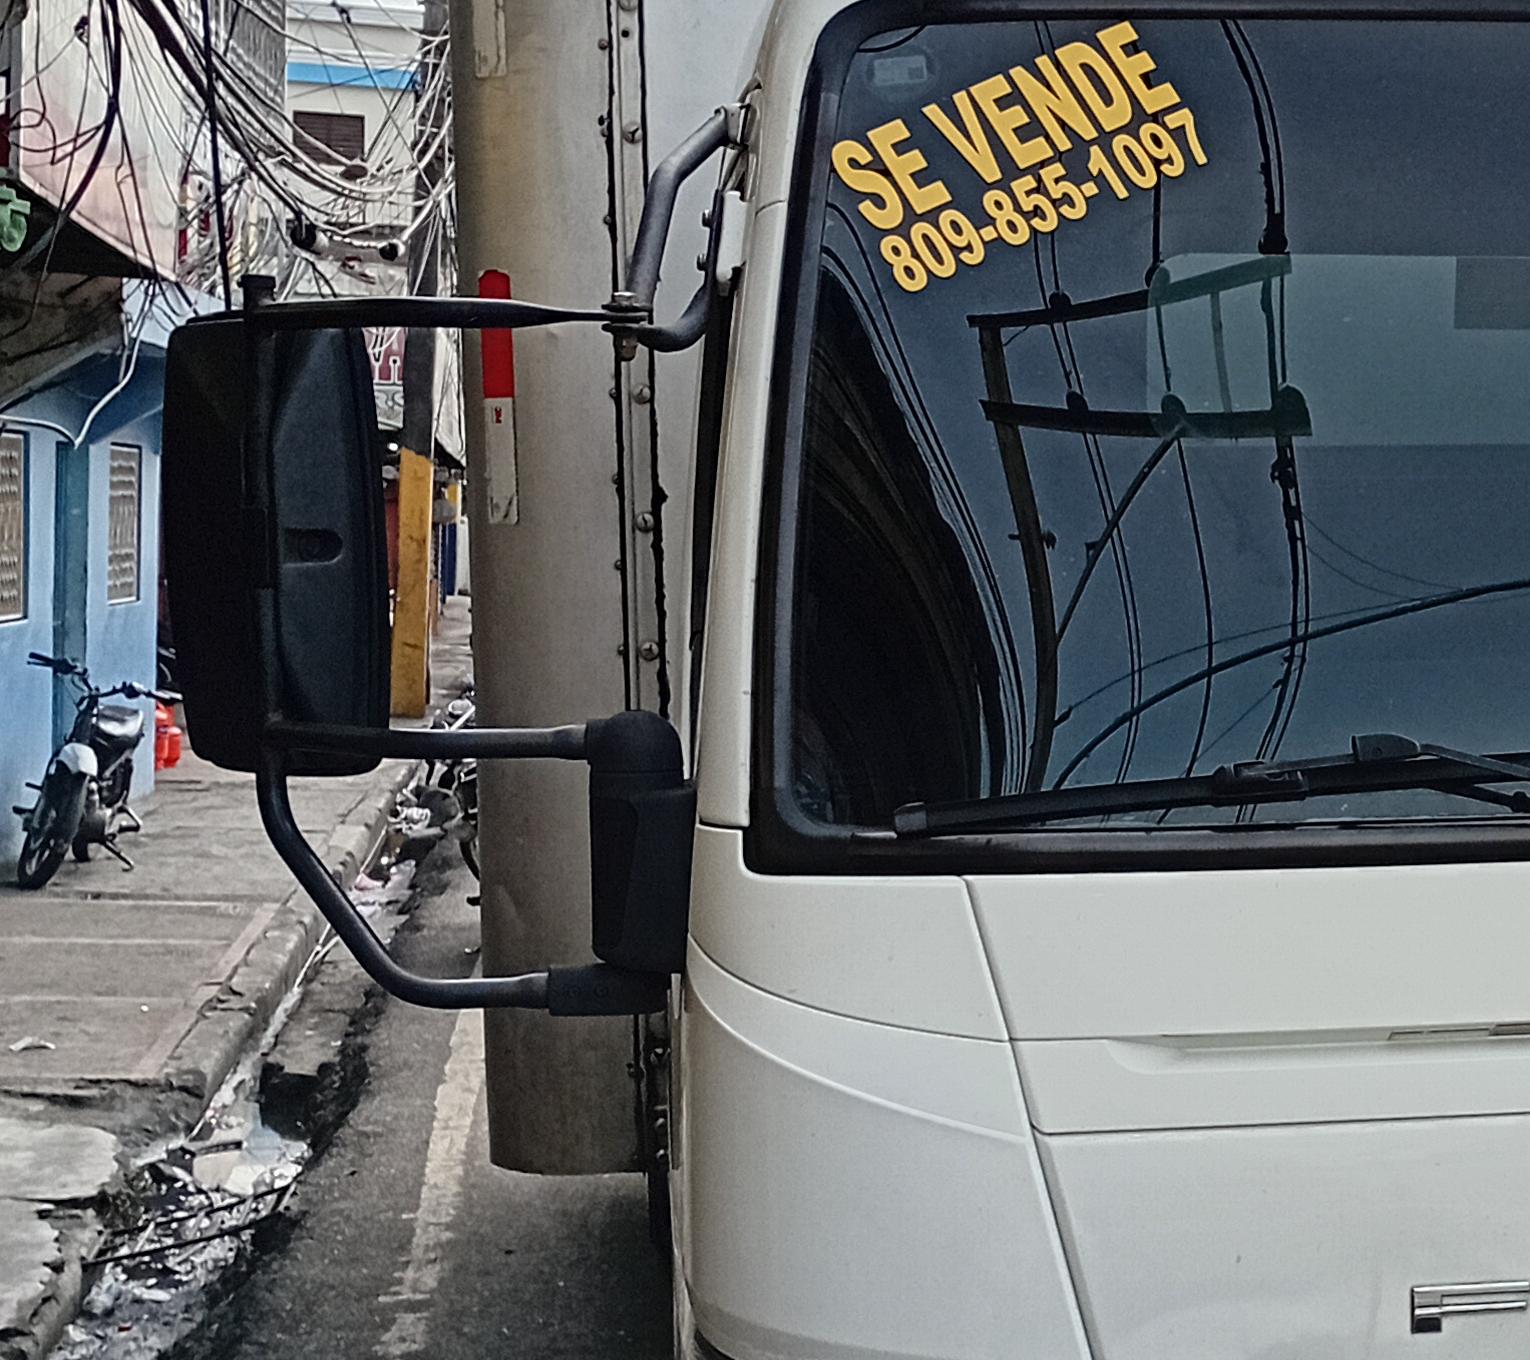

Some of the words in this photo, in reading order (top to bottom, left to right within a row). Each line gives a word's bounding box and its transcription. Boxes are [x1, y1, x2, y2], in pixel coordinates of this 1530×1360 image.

[831, 118, 952, 230] SE
[921, 20, 1182, 184] VENDE
[879, 107, 1209, 293] 809-855-1097
